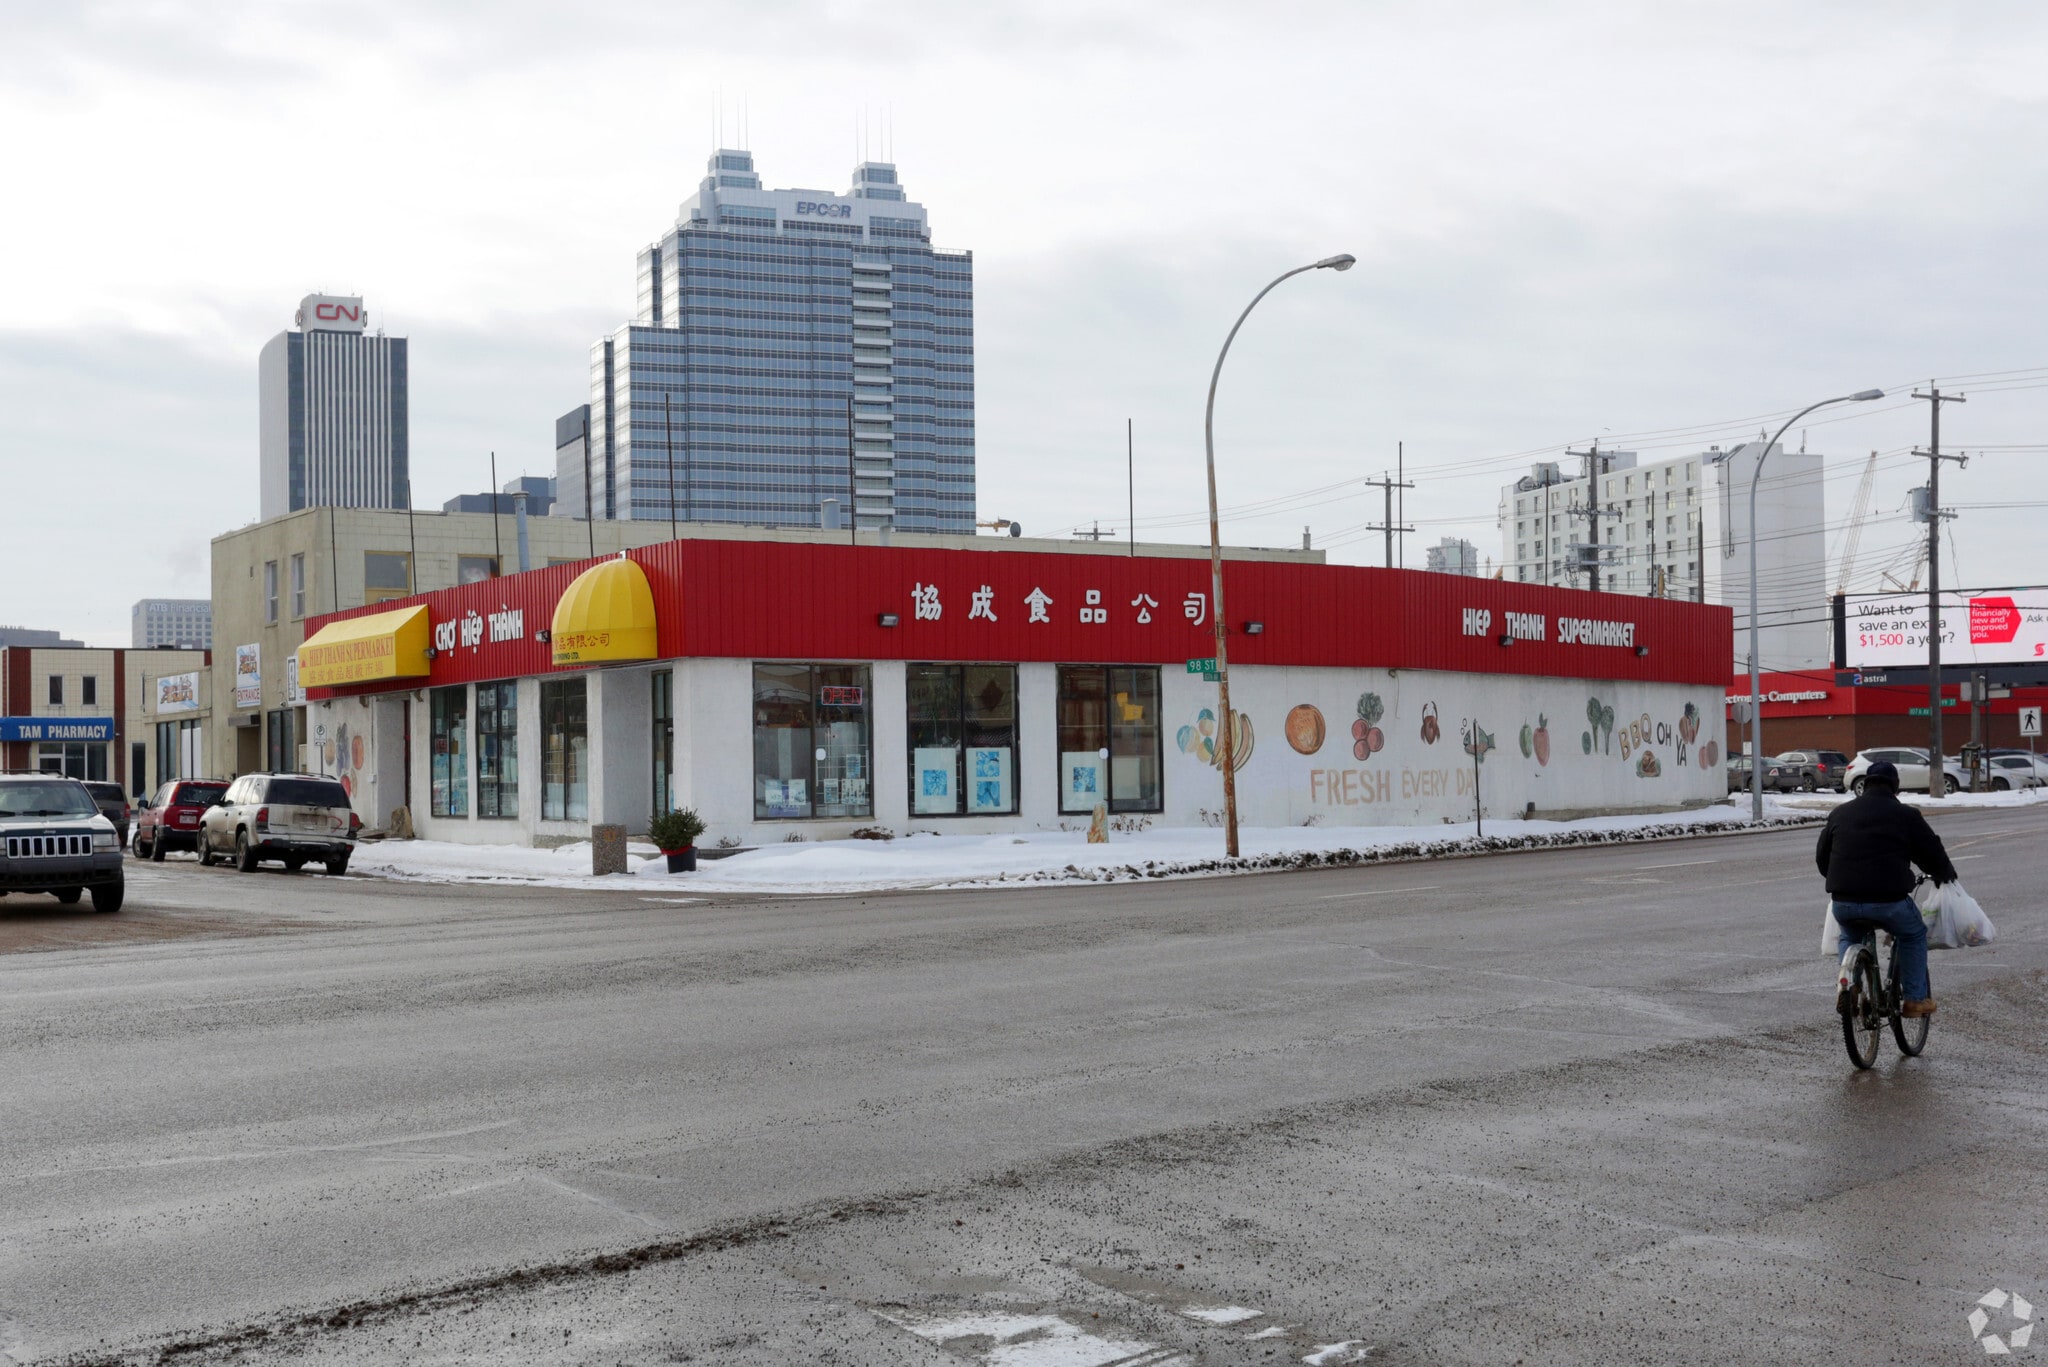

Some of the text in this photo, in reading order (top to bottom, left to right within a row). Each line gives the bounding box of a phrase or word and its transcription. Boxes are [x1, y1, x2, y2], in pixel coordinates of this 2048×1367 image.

[796, 201, 852, 218] EPCOR
[316, 303, 359, 322] CN
[149, 603, 211, 613] ATB Financial
[911, 582, 1206, 626] 協成食品公司
[1858, 604, 1914, 616] Want to
[1972, 608, 2011, 618] financially
[2026, 614, 2043, 623] Ask
[435, 618, 457, 657] CHỢ
[488, 603, 524, 643] THÀNH
[1462, 607, 1635, 648] HIEP THANH SUPERMARKET
[1859, 619, 1947, 631] save an exa
[1971, 623, 2008, 632] improved
[1859, 632, 1955, 648] $1,500 a yer?
[1972, 632, 1989, 640] you.
[309, 636, 394, 667] HIEP THANH SUPERMARKET
[1190, 660, 1215, 671] 98 ST
[1863, 674, 1887, 683] astral
[237, 688, 260, 702] ENTRANCE
[822, 687, 861, 704] OPEN
[1768, 690, 1827, 704] Computers
[18, 725, 42, 739] TAM
[48, 725, 107, 739] PHARMACY
[1618, 713, 1687, 767] BBQ OH YA
[1310, 767, 1481, 806] FRESH EVERY DAY
